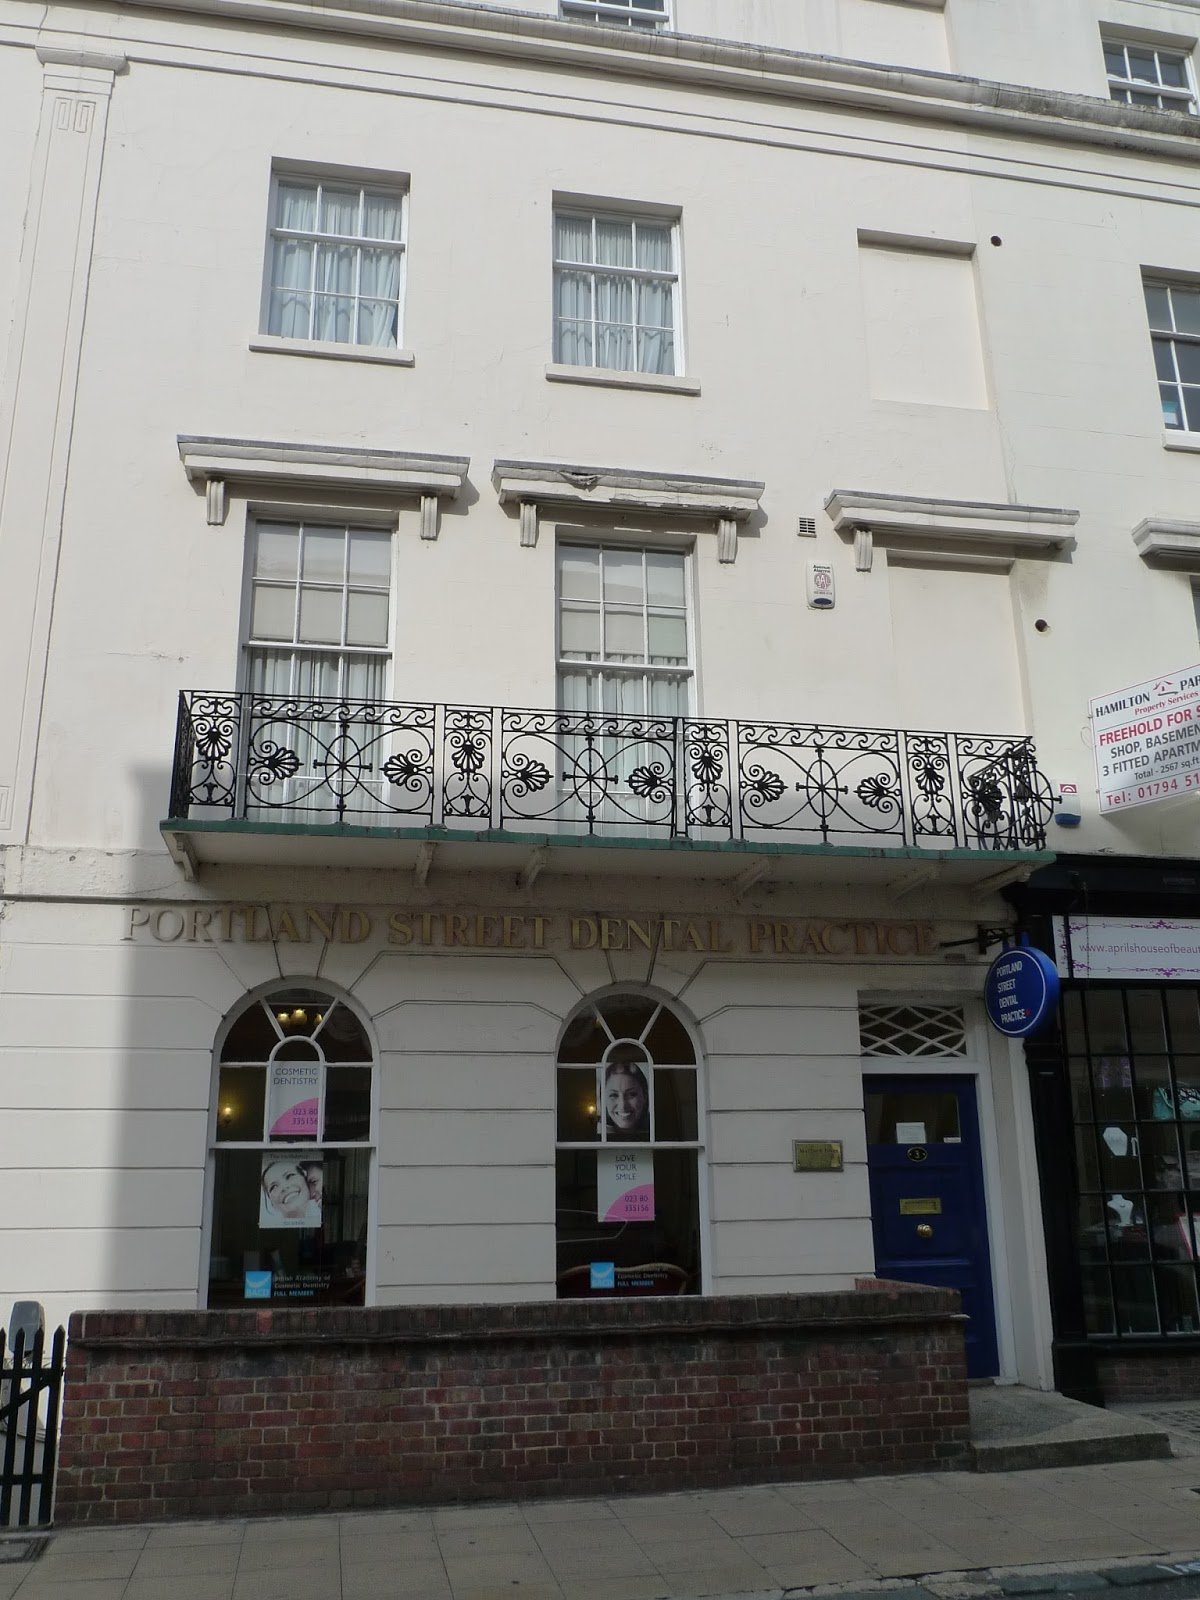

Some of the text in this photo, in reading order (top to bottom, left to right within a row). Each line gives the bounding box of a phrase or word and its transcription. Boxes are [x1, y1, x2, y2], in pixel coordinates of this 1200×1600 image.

[1095, 692, 1150, 718] HAMILTON
[1134, 690, 1199, 716] Property Services
[1099, 718, 1163, 746] FREEHOLD
[1167, 709, 1192, 727] FOR
[1110, 743, 1142, 759] SHOP,
[1102, 765, 1109, 776] 3
[1113, 755, 1150, 775] FITTED
[1134, 770, 1154, 781] Total
[1160, 761, 1178, 774] 2567
[1106, 791, 1131, 806] Tel:
[1137, 778, 1178, 798] 01794
[119, 907, 939, 956] PORTLAND STREET DENTAL PRACTICE
[996, 961, 1023, 977] PORTLAND
[997, 978, 1016, 993] STREET
[999, 995, 1019, 1008] DENTAL
[1000, 1008, 1027, 1024] PRACTICE
[275, 1067, 318, 1076] COSMETIC
[273, 1077, 319, 1085] DENTISTRY
[615, 1154, 636, 1162] LOVE
[615, 1164, 637, 1172] YOUR
[615, 1173, 636, 1181] SMILE
